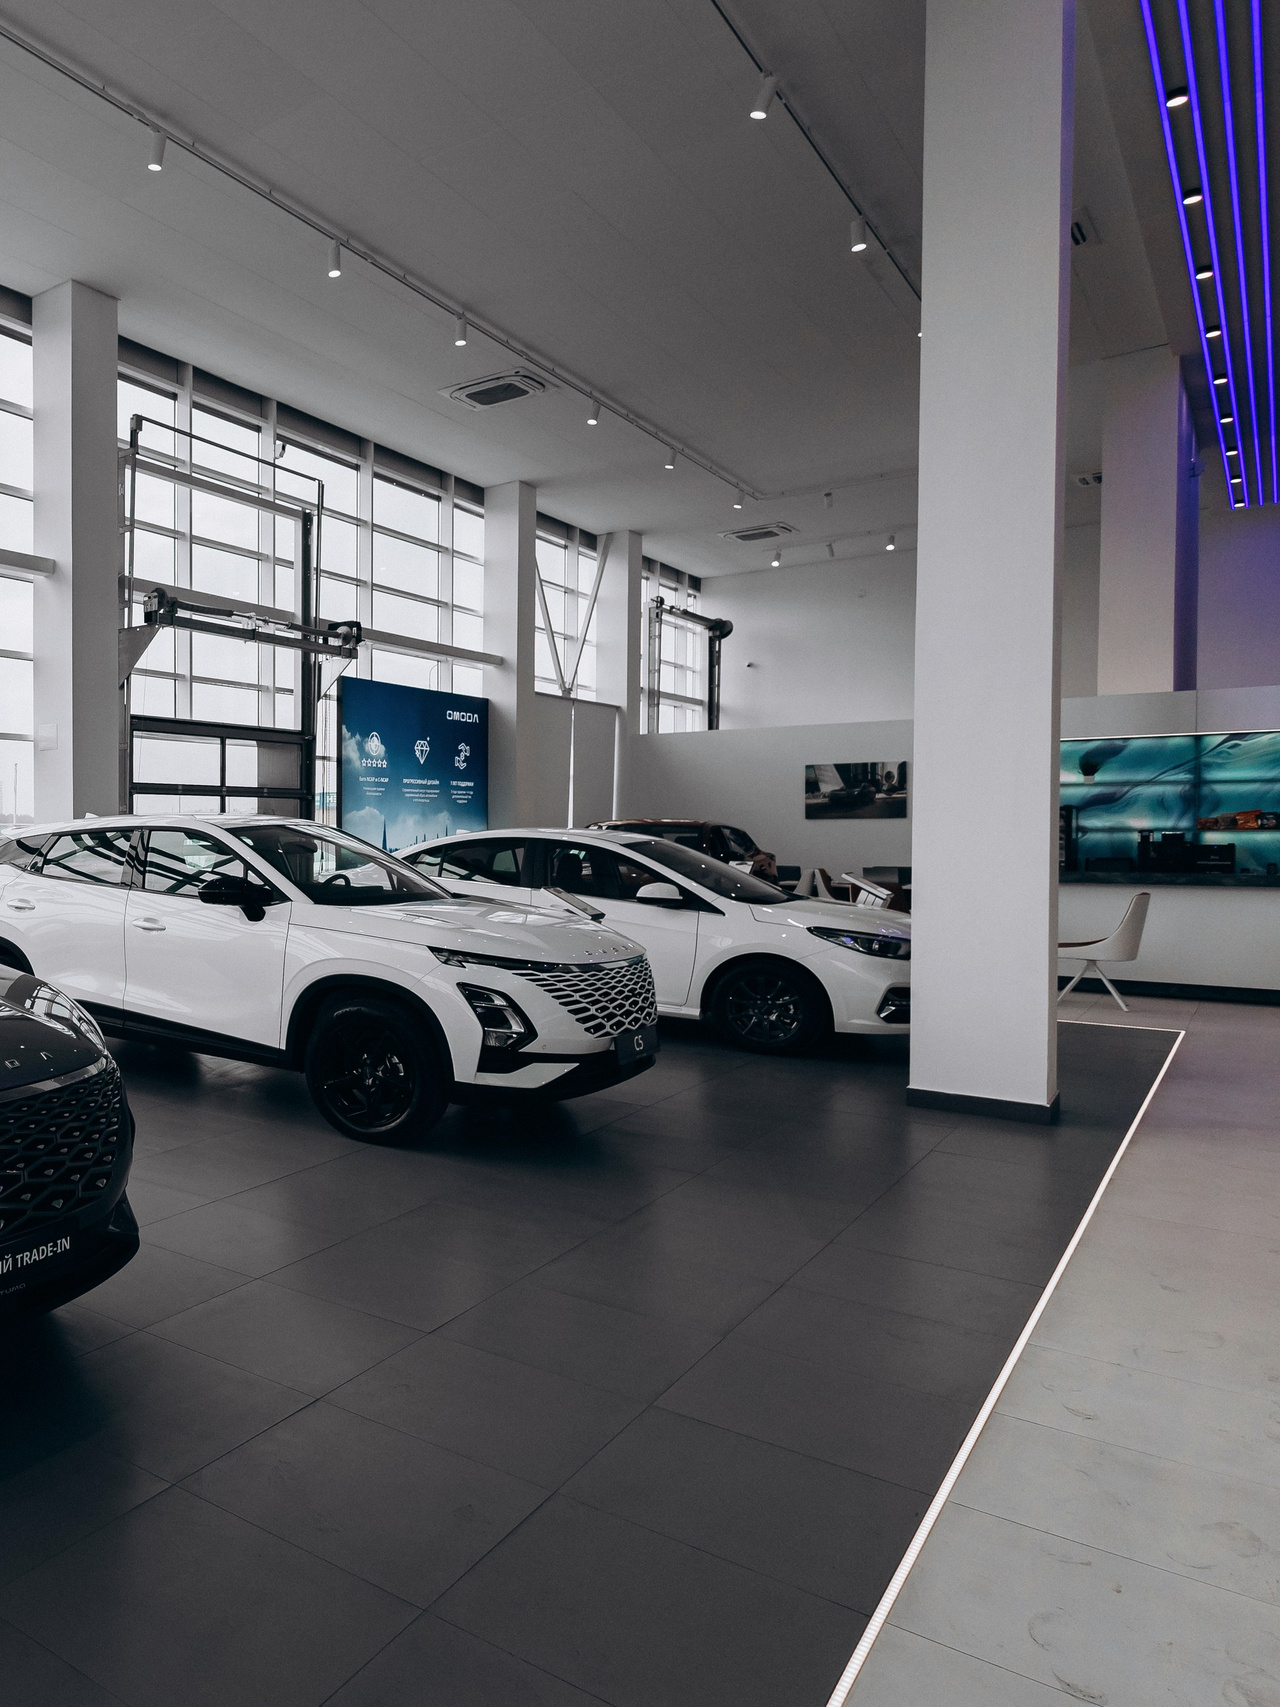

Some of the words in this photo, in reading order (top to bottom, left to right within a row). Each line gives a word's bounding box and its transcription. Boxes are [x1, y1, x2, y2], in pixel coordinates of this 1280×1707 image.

[446, 710, 479, 723] OMODA
[634, 1035, 644, 1051] C5
[15, 1236, 70, 1268] TRADE-IN
